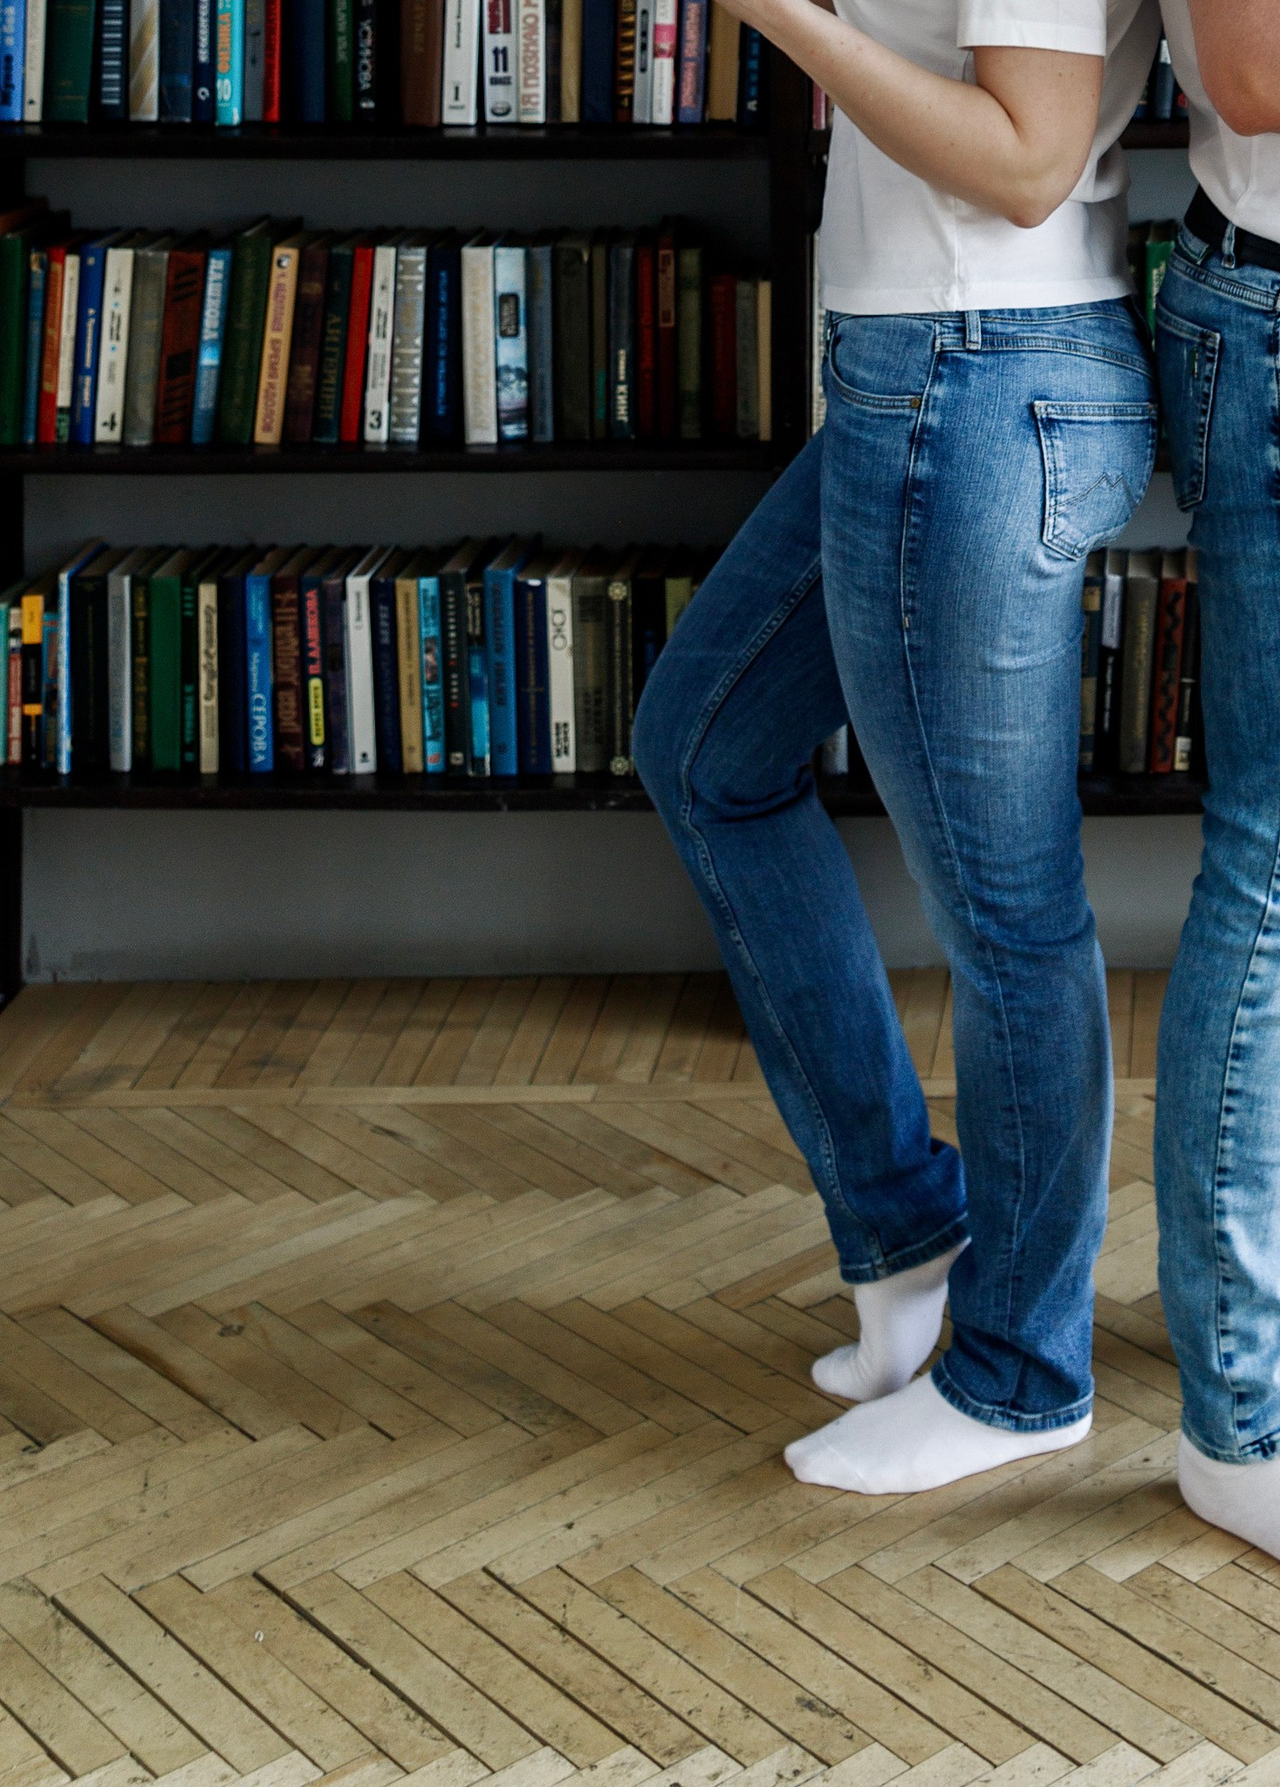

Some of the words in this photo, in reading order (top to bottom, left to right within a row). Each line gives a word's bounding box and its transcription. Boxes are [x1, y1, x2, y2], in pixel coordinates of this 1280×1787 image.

[217, 12, 232, 74] ФИЗИКА
[523, 13, 540, 88] ПОЗНАЮ
[617, 384, 629, 423] КИНГ
[250, 693, 267, 765] СЕРОВА
